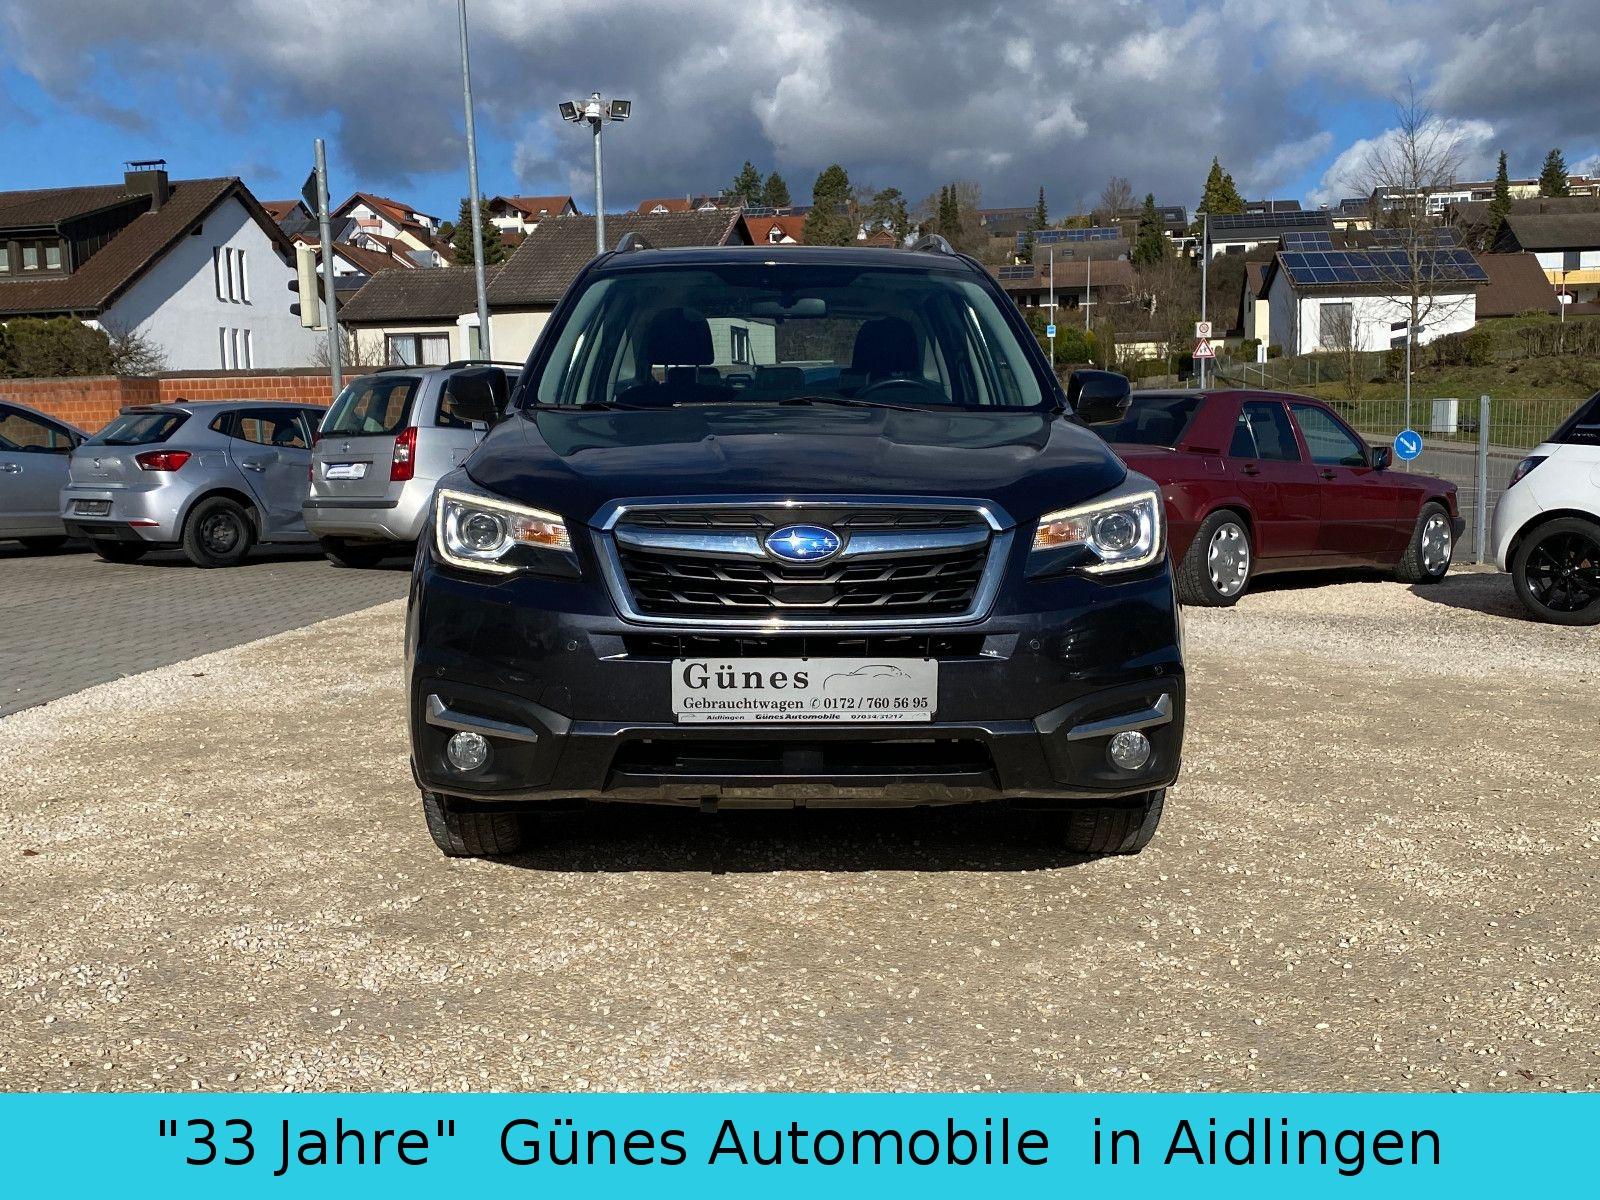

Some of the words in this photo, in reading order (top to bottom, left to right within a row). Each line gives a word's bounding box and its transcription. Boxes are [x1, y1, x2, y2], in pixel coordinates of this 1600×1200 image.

[683, 662, 809, 690] Günes
[683, 697, 804, 711] Gebrauchtwagen
[823, 697, 855, 709] 0172
[867, 697, 890, 709] 760
[893, 697, 908, 709] 56
[912, 697, 928, 709] 95
